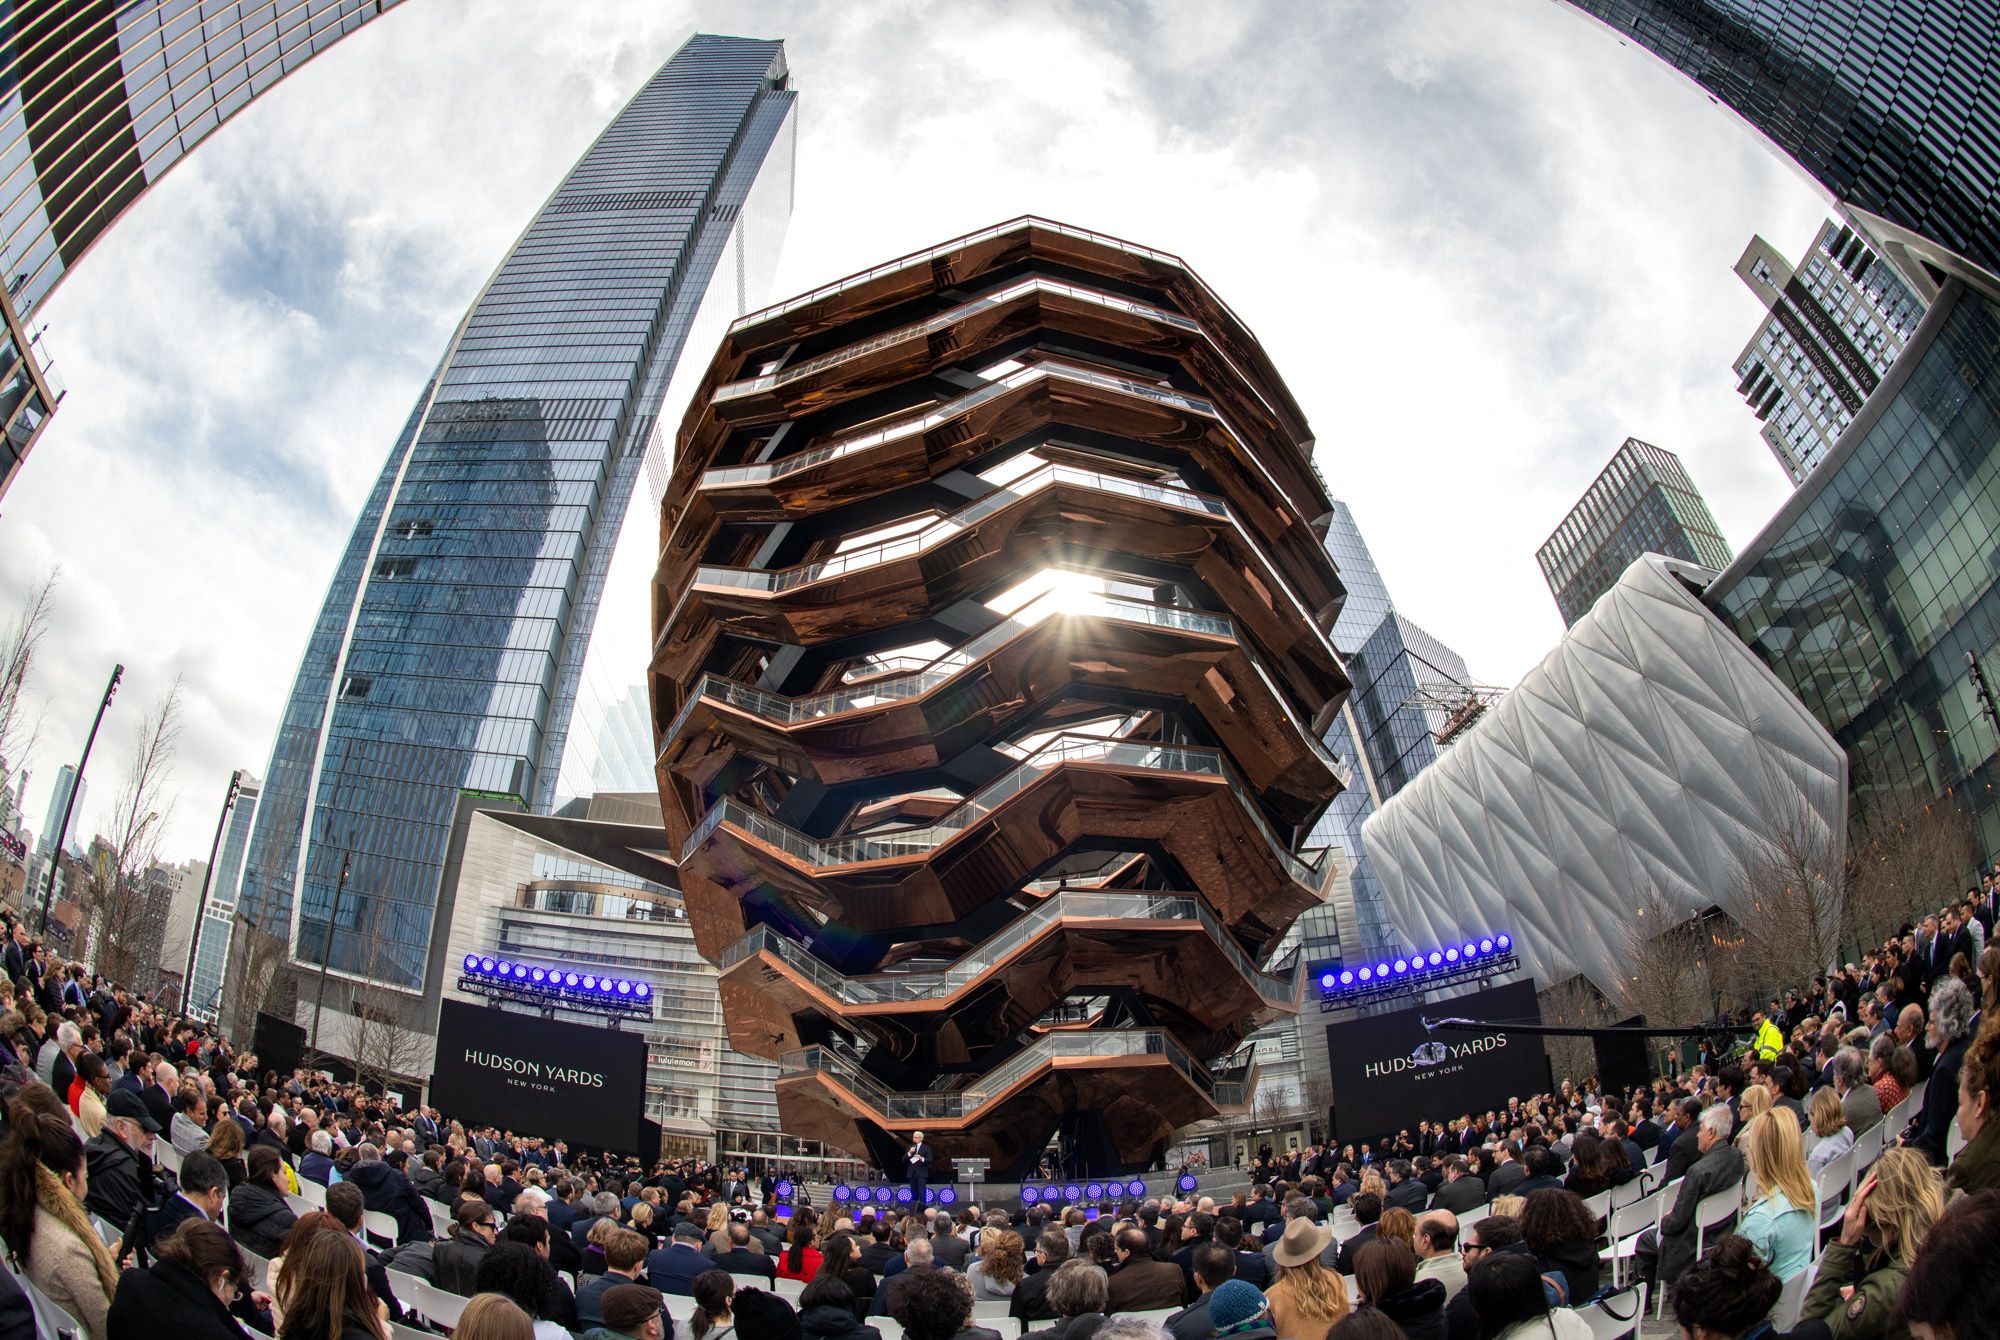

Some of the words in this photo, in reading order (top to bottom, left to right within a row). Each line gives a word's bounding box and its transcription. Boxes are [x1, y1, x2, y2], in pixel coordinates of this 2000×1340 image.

[1780, 312, 1803, 339] rentals
[1801, 338, 1838, 386] ohmny.com
[1801, 299, 1825, 330] there's
[1825, 328, 1837, 343] no
[1836, 343, 1858, 369] place
[1857, 367, 1872, 388] like
[465, 1049, 539, 1077] HUDSON
[545, 1065, 604, 1088] YARDS
[658, 1055, 696, 1067] lululemon
[1365, 1056, 1417, 1078] HUDS
[1449, 1033, 1507, 1059] YARDS
[1414, 1071, 1435, 1080] NEW
[1439, 1064, 1464, 1075] YORK
[507, 1078, 527, 1087] NEW
[531, 1083, 556, 1093] YORK
